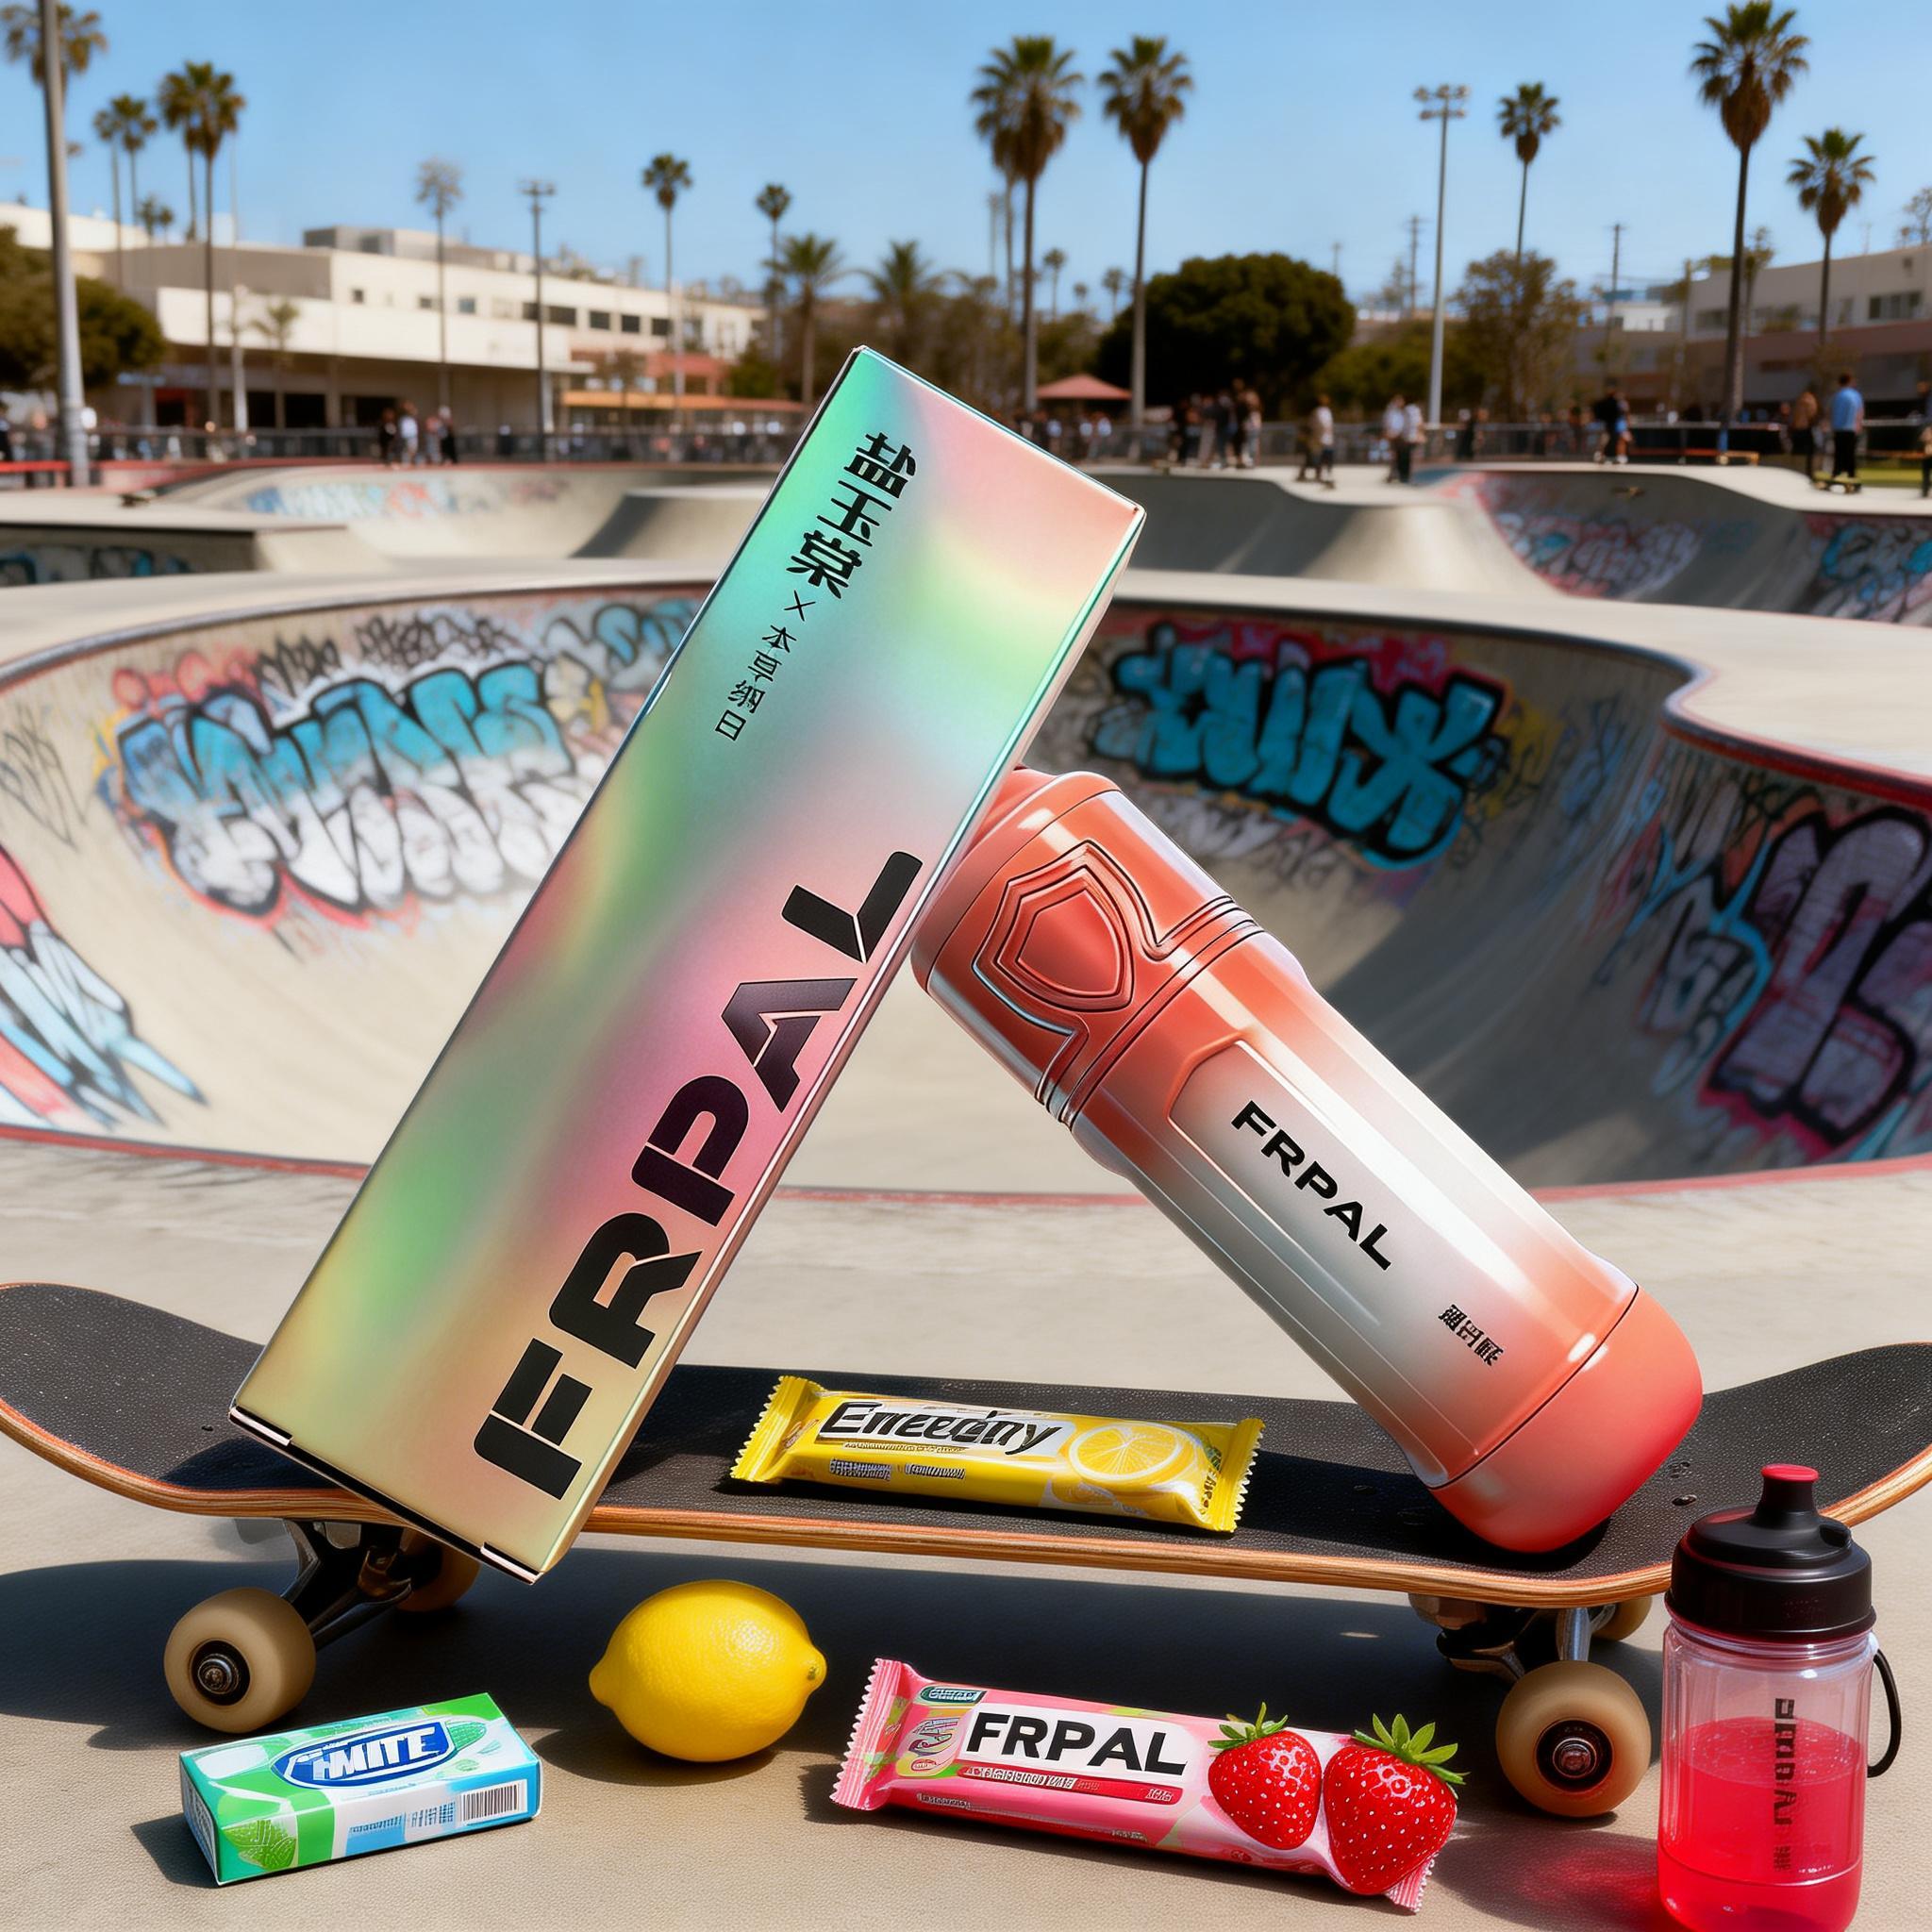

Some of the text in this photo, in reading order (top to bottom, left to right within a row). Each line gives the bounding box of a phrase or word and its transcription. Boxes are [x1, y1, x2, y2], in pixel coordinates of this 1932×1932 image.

[473, 851, 924, 1501] FRPAL
[1230, 1100, 1391, 1271] FRPAL
[966, 1711, 1188, 1776] FRPAL
